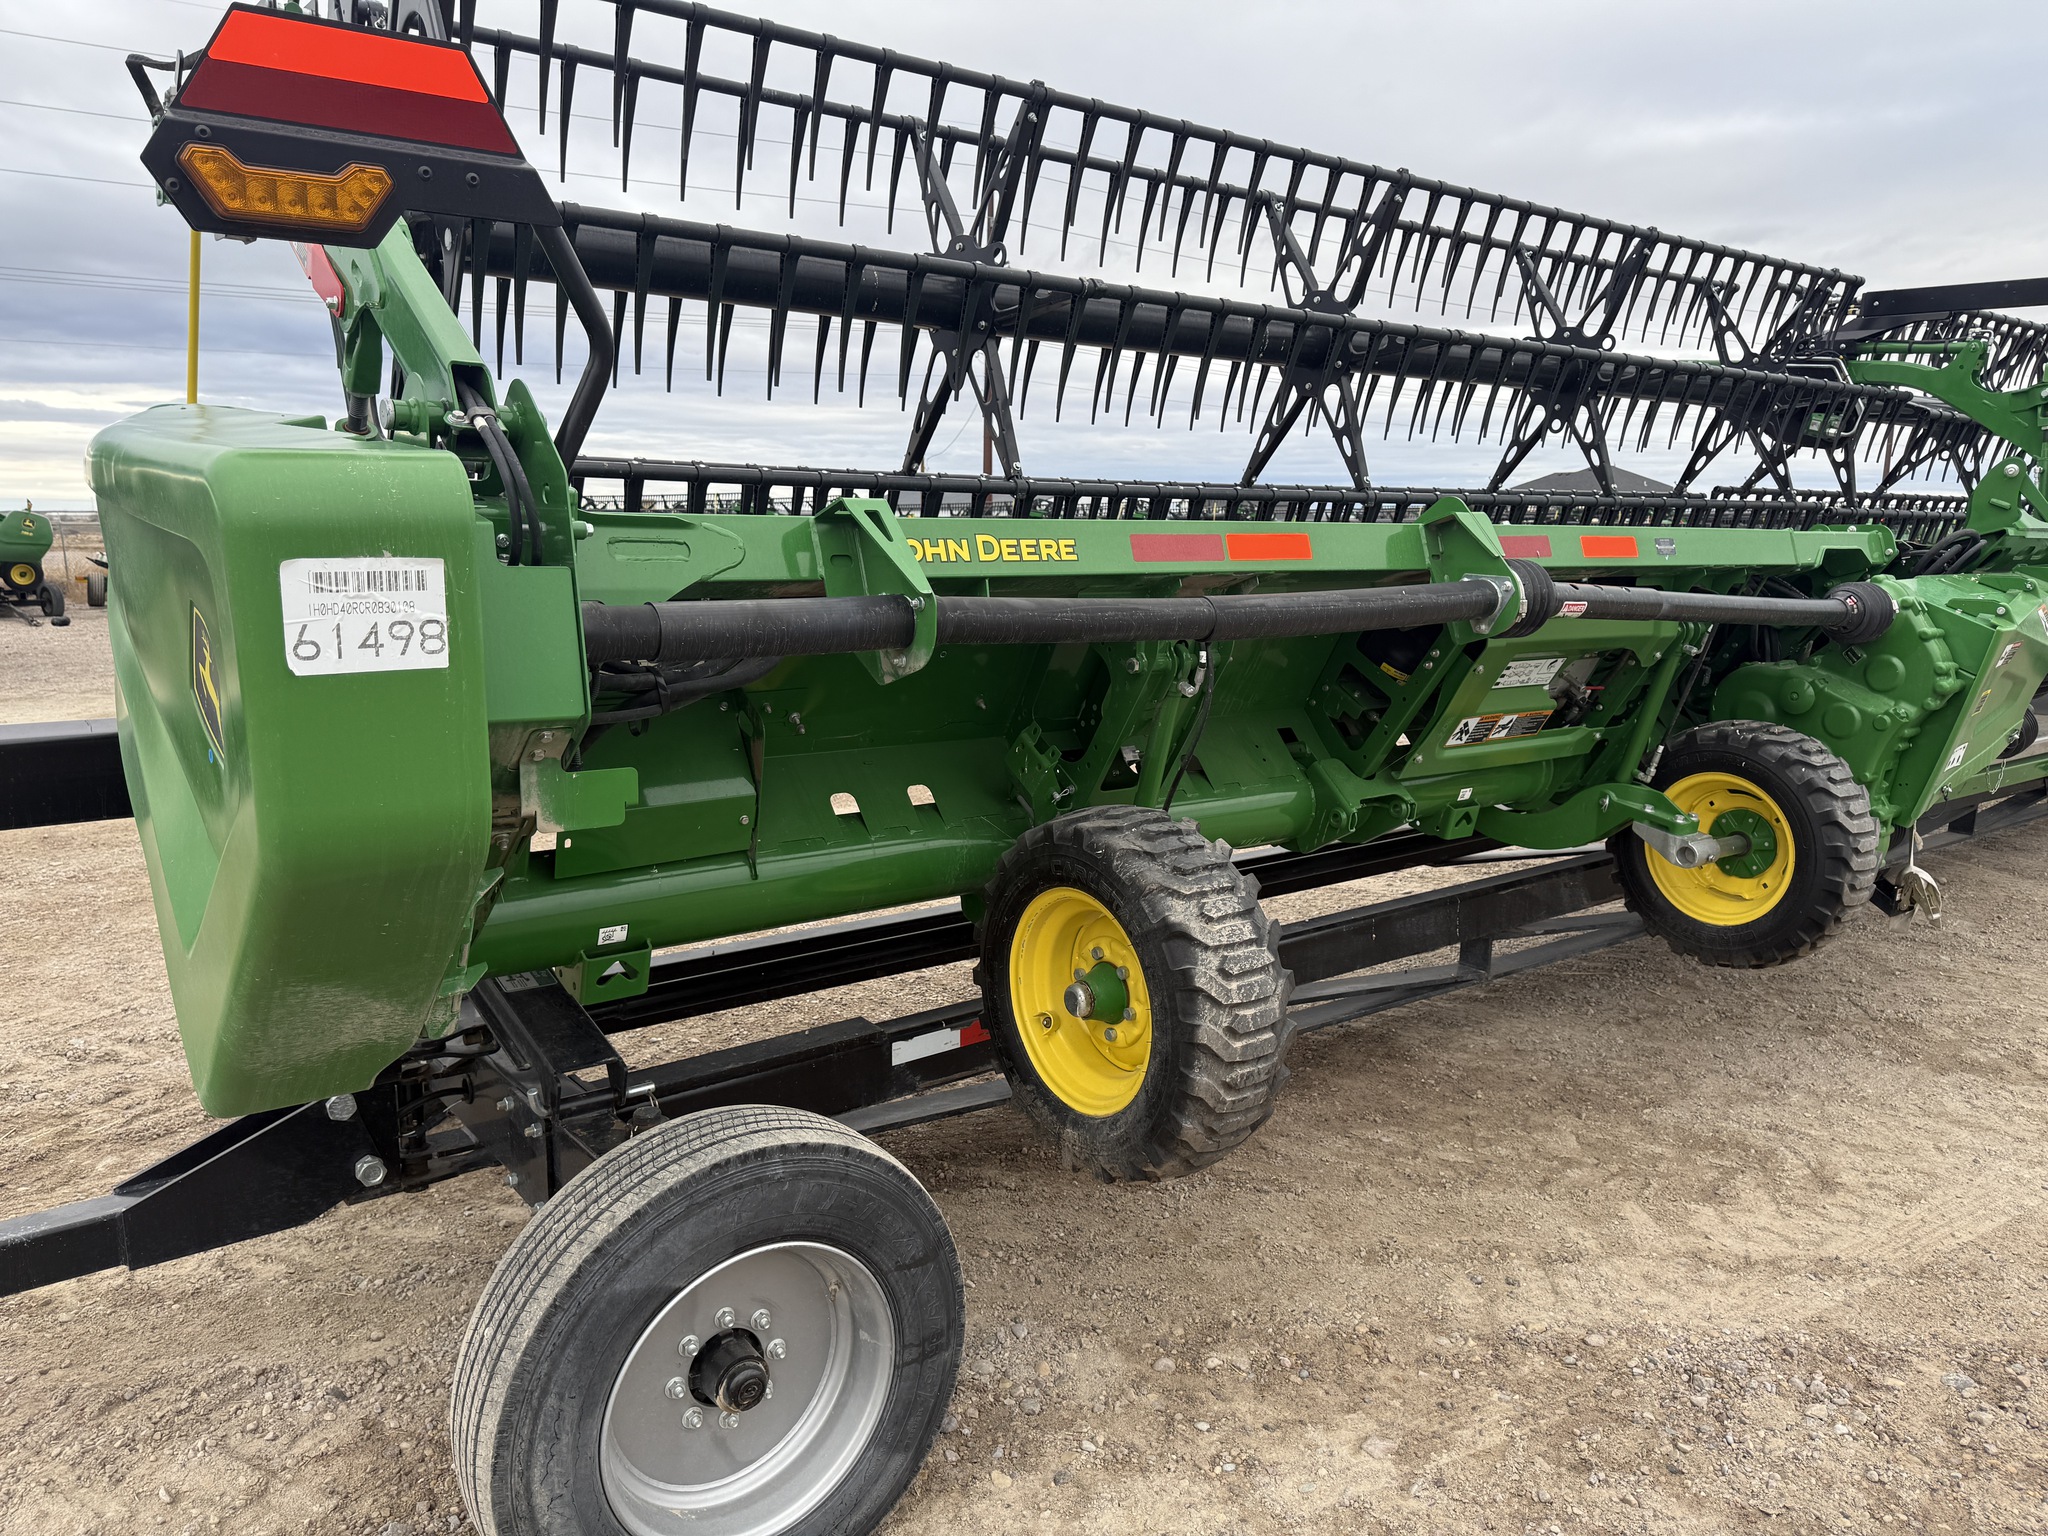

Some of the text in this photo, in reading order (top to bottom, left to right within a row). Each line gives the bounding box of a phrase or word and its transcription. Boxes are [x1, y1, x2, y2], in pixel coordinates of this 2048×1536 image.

[906, 533, 1079, 562] OHN DEERE
[292, 619, 447, 661] 61498
